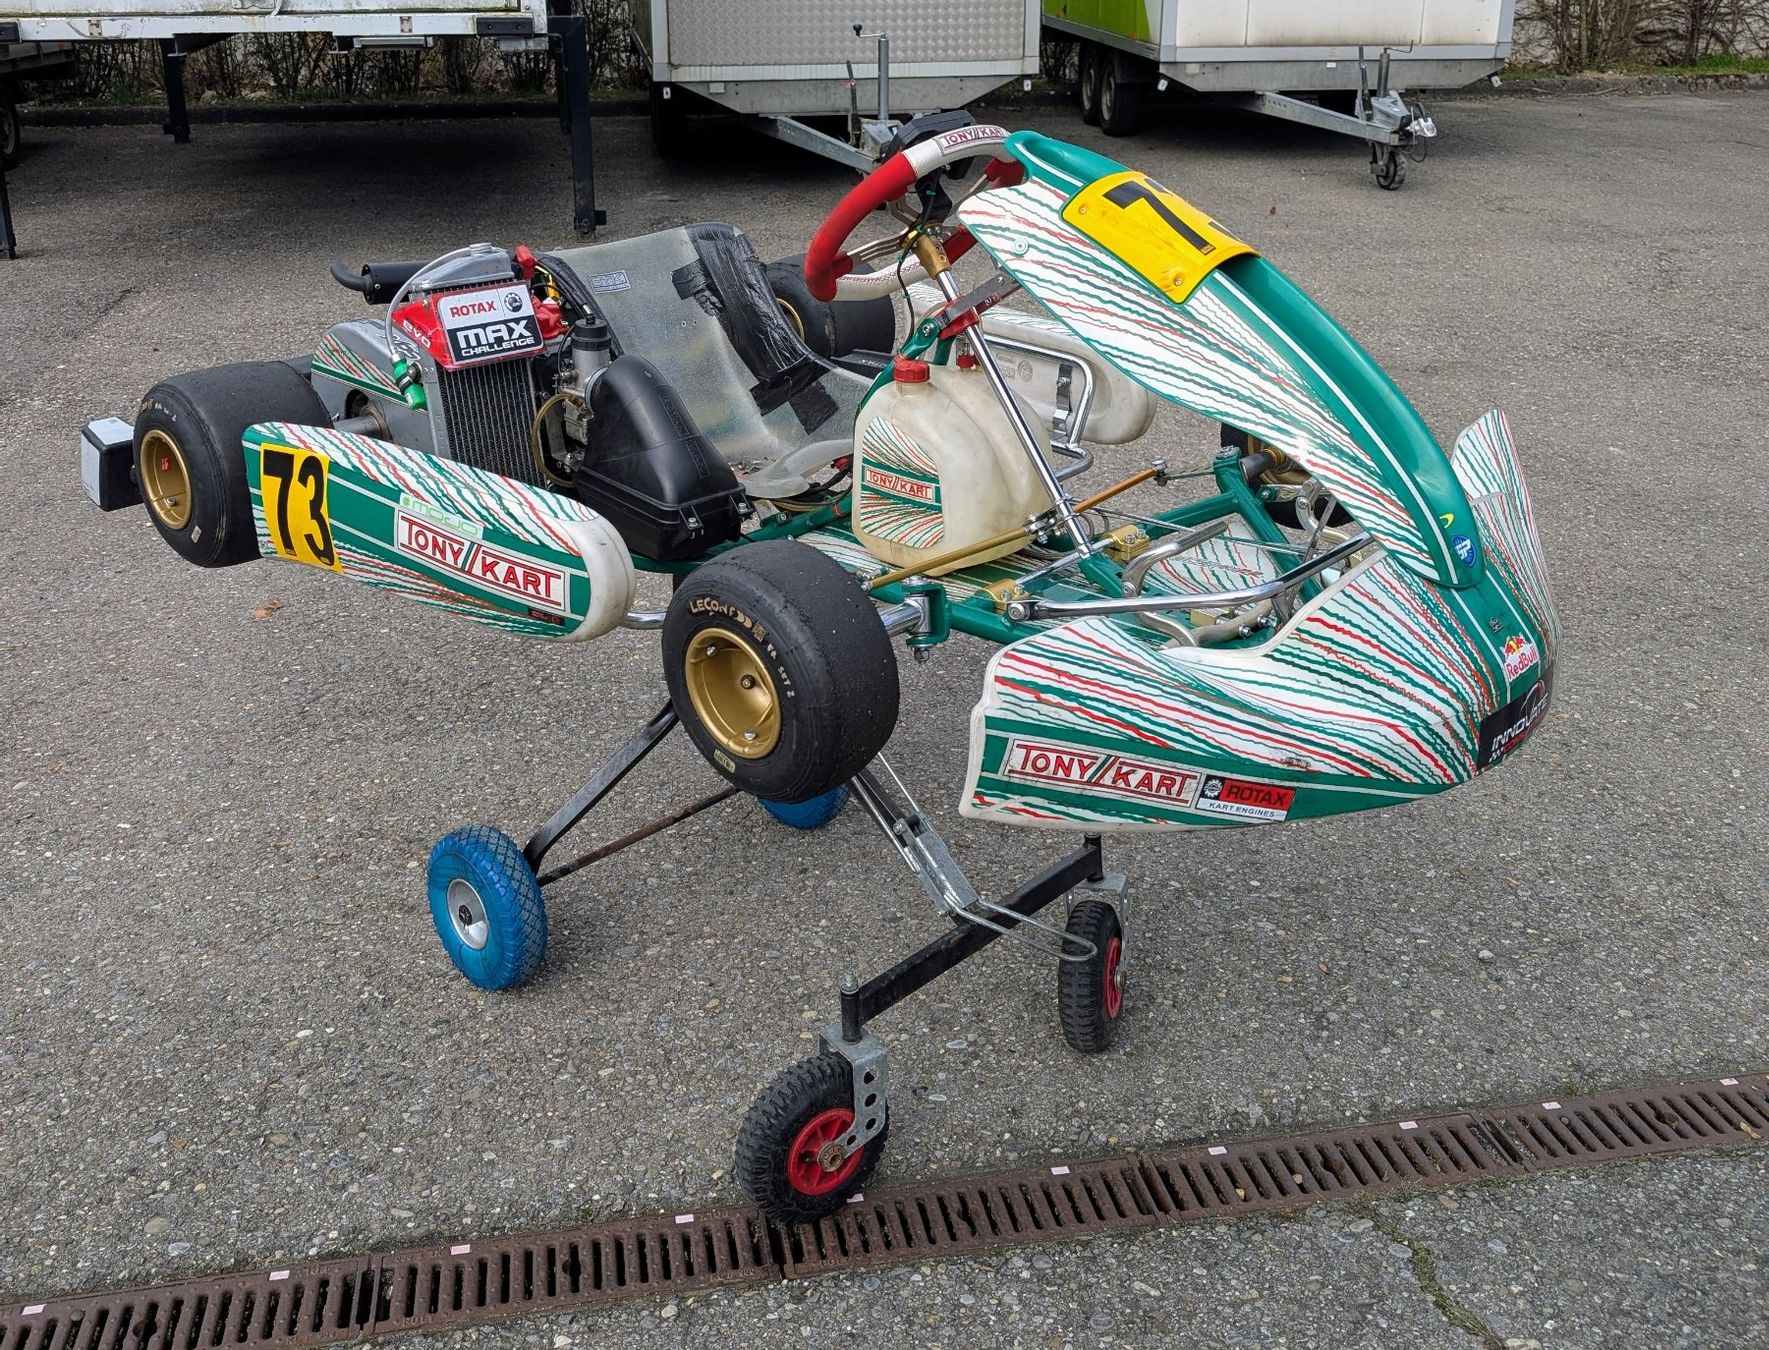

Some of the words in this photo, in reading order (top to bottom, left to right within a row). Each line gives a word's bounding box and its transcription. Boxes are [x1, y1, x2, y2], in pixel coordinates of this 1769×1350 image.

[944, 128, 973, 145] TONY
[450, 300, 497, 318] ROTAX
[461, 337, 536, 357] CHALLENGE
[868, 469, 893, 490] TONY
[899, 479, 931, 498] KART
[263, 449, 335, 567] 73
[401, 515, 464, 566] TONY
[481, 552, 562, 598] KART
[1016, 744, 1099, 779] TONY
[1113, 761, 1198, 797] KART
[1225, 784, 1288, 807] ROTAX
[1209, 802, 1235, 811] KART
[1236, 805, 1275, 818] ENGINES
